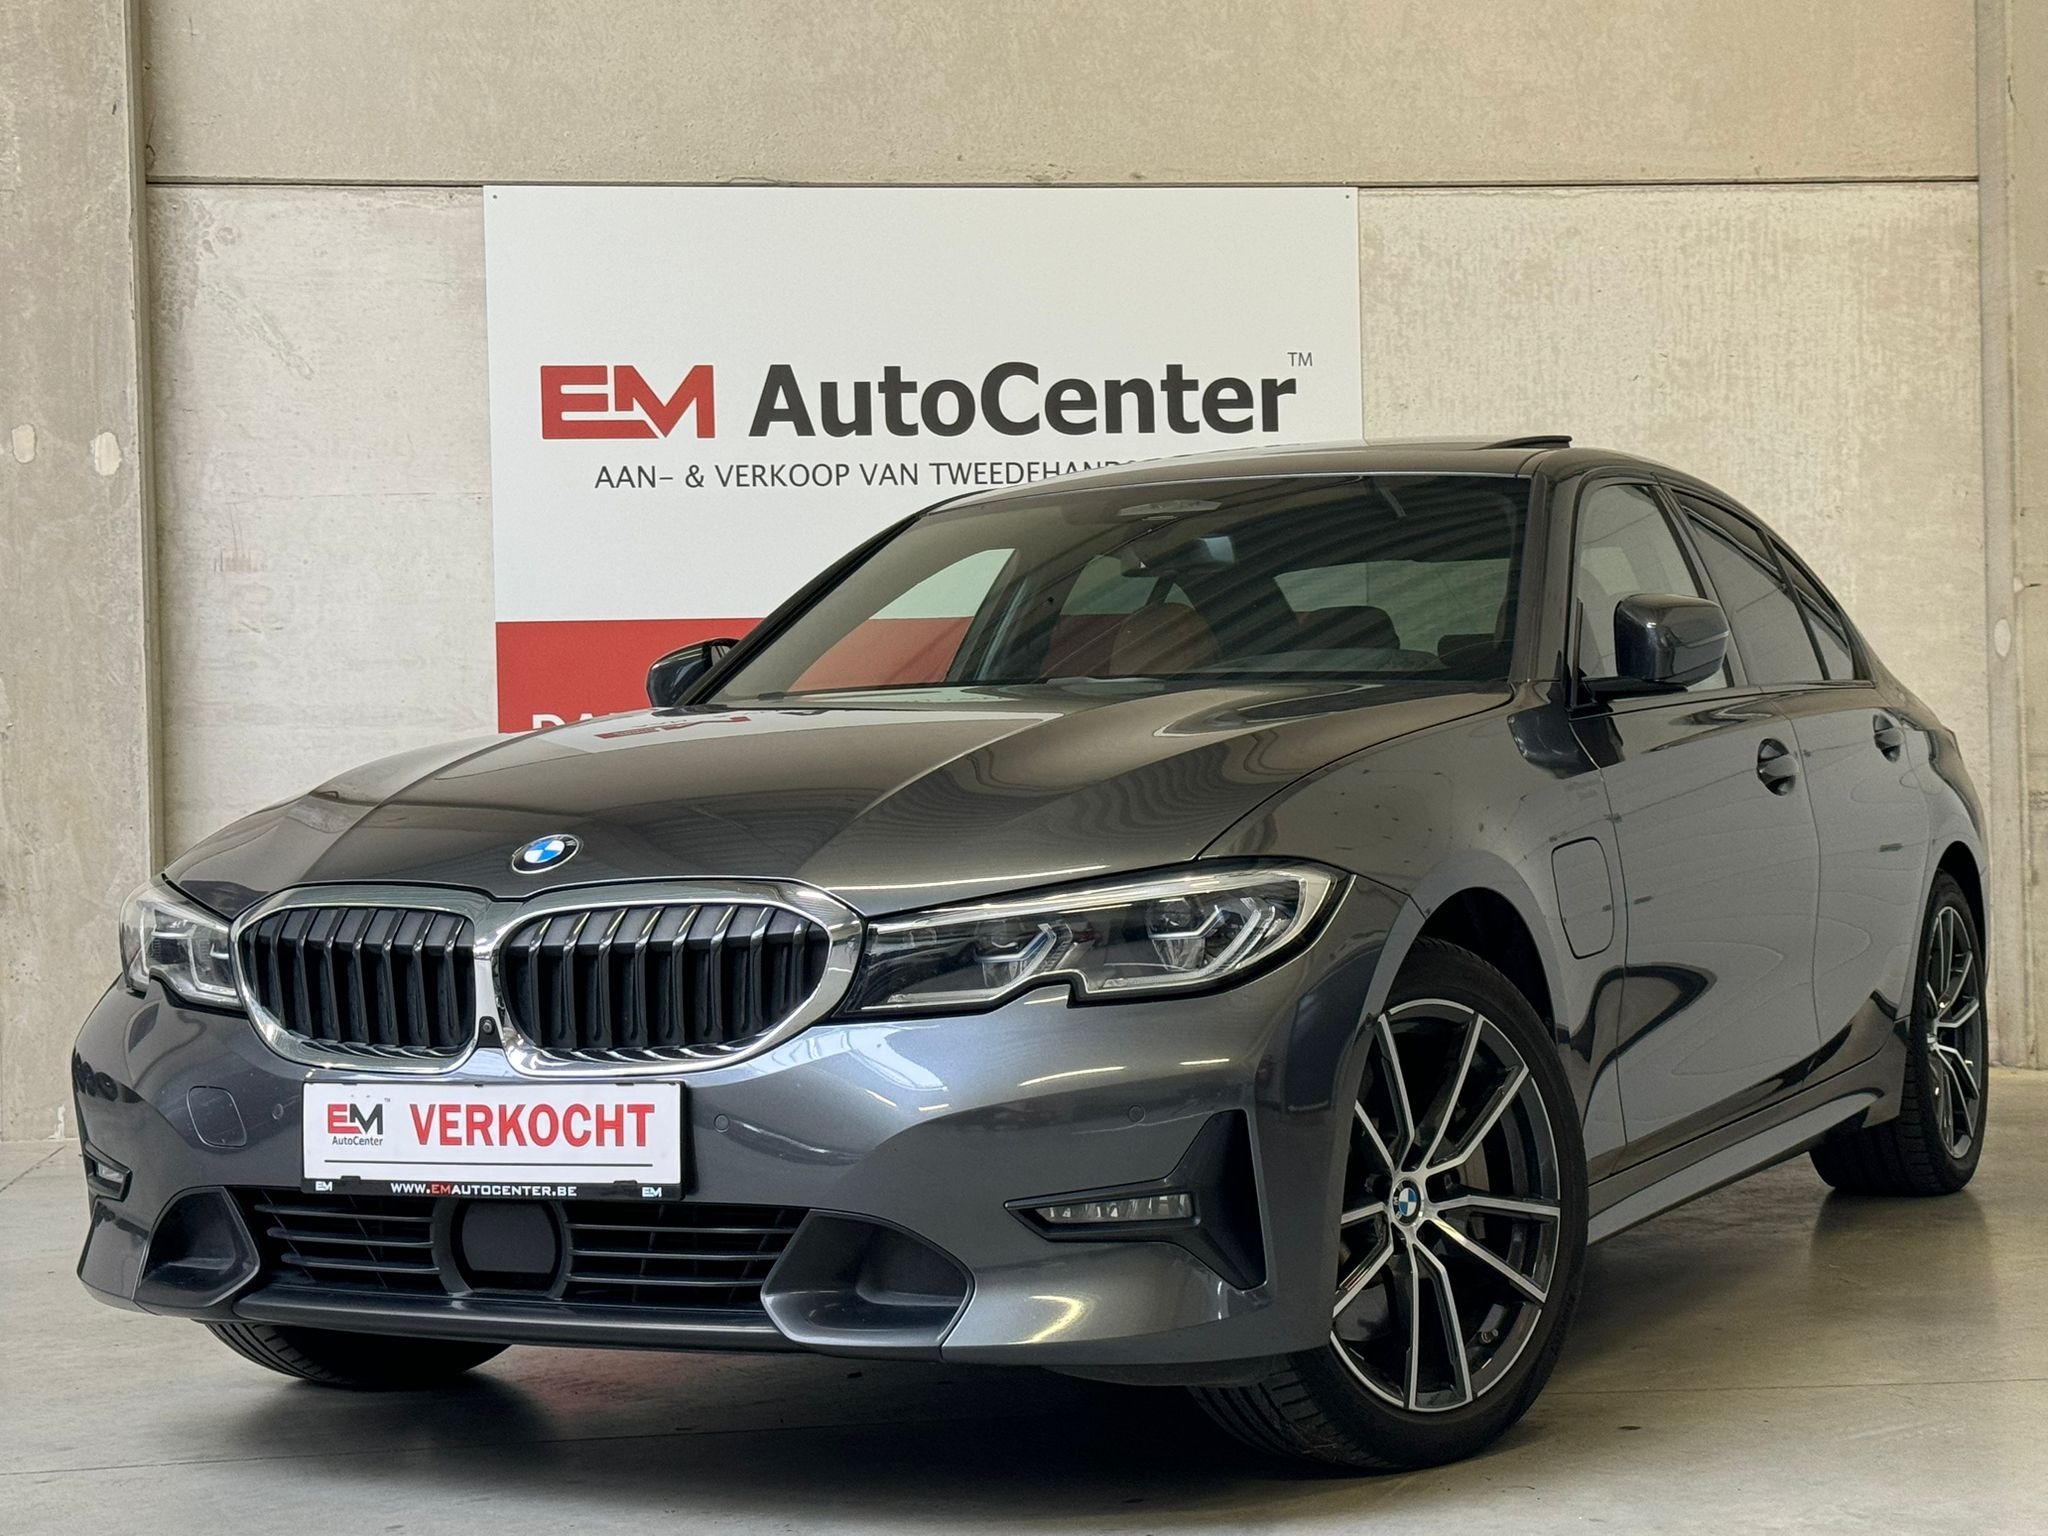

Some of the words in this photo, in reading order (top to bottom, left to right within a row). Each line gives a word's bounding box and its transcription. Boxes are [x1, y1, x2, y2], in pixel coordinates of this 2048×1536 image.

[541, 365, 716, 440] EM
[748, 361, 1297, 438] AutoCenter
[685, 464, 705, 487] &
[715, 463, 850, 487] VERKOOP
[859, 463, 918, 486] VAN
[327, 1103, 384, 1135] EM
[409, 1103, 656, 1147] VERKOCHT
[331, 1135, 384, 1147] AutoCenter
[315, 1181, 333, 1192] EM
[390, 1182, 577, 1197] WWW.EMAUTOCENTER.BE
[641, 1187, 663, 1198] EM
